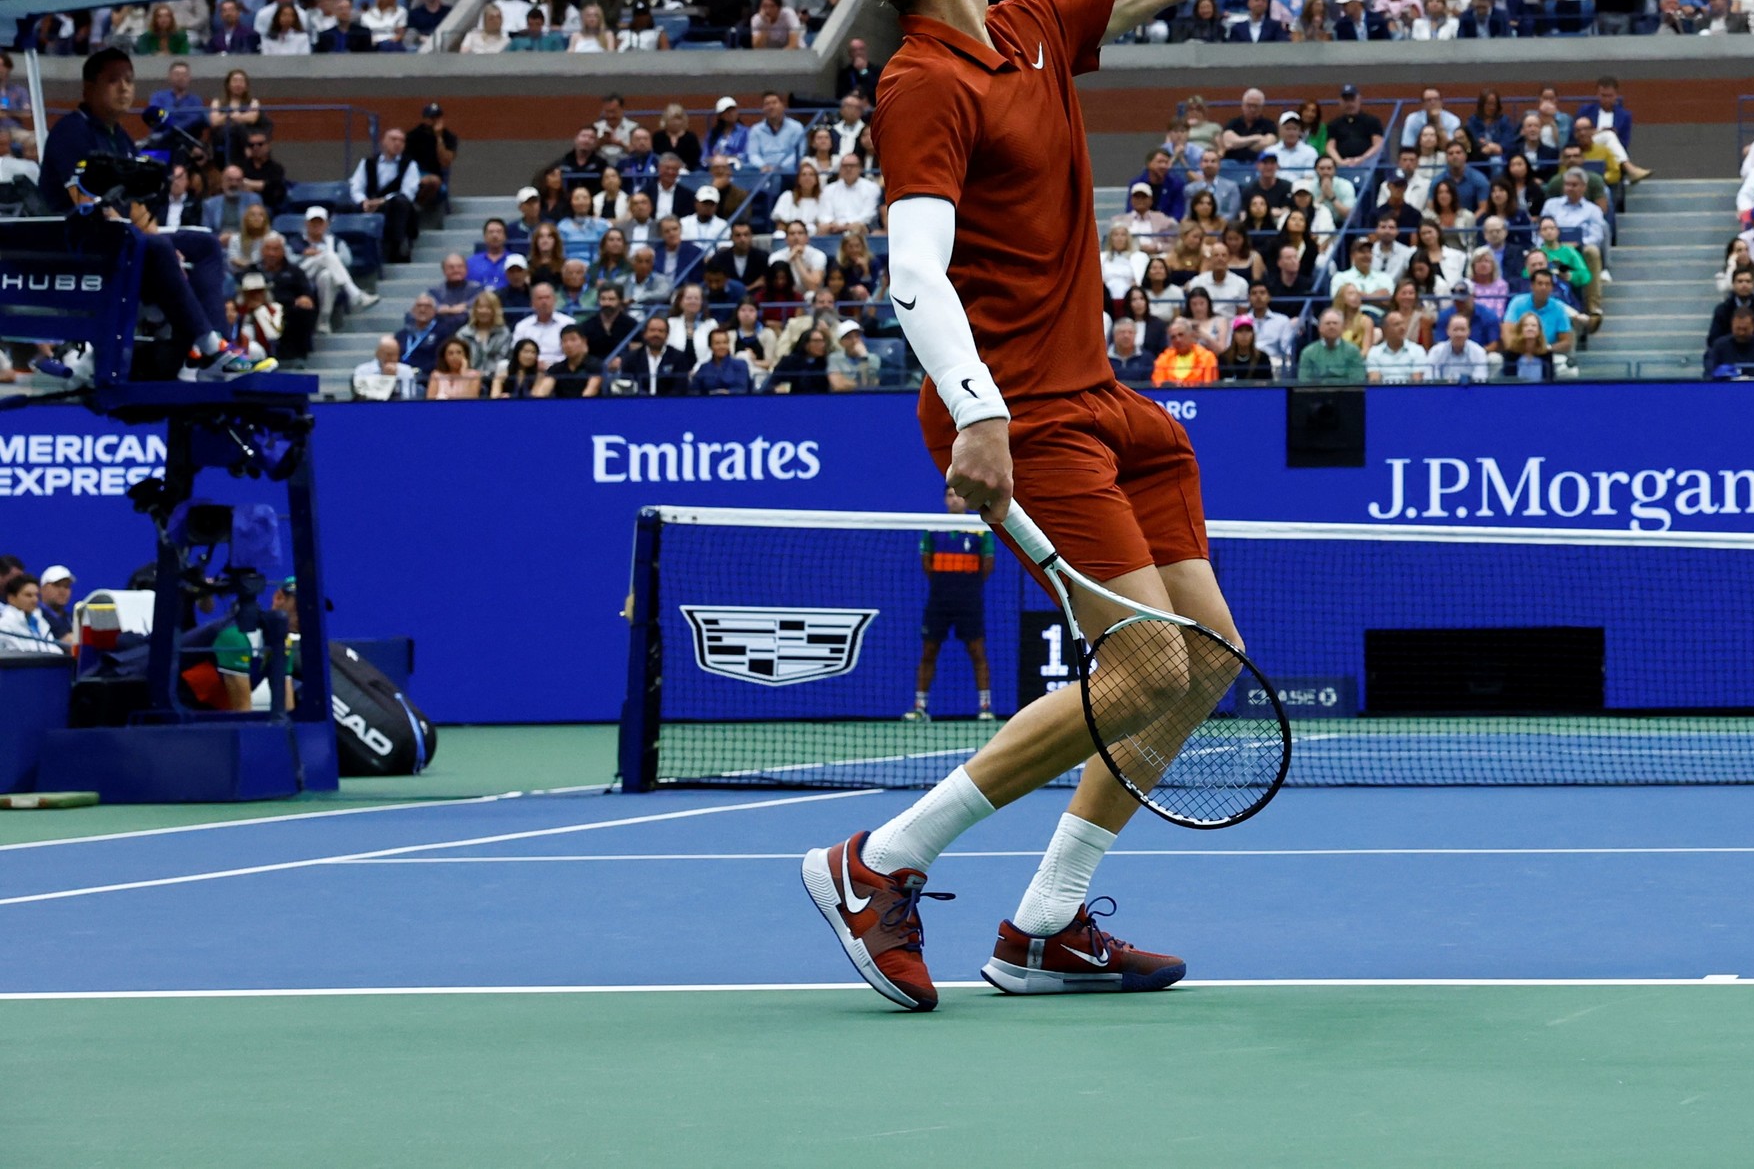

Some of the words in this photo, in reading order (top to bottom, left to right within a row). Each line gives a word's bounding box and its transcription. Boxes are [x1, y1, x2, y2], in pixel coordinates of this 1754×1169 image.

[1155, 400, 1198, 420] RG
[591, 431, 820, 483] Emirates
[0, 466, 166, 496] EXPRES
